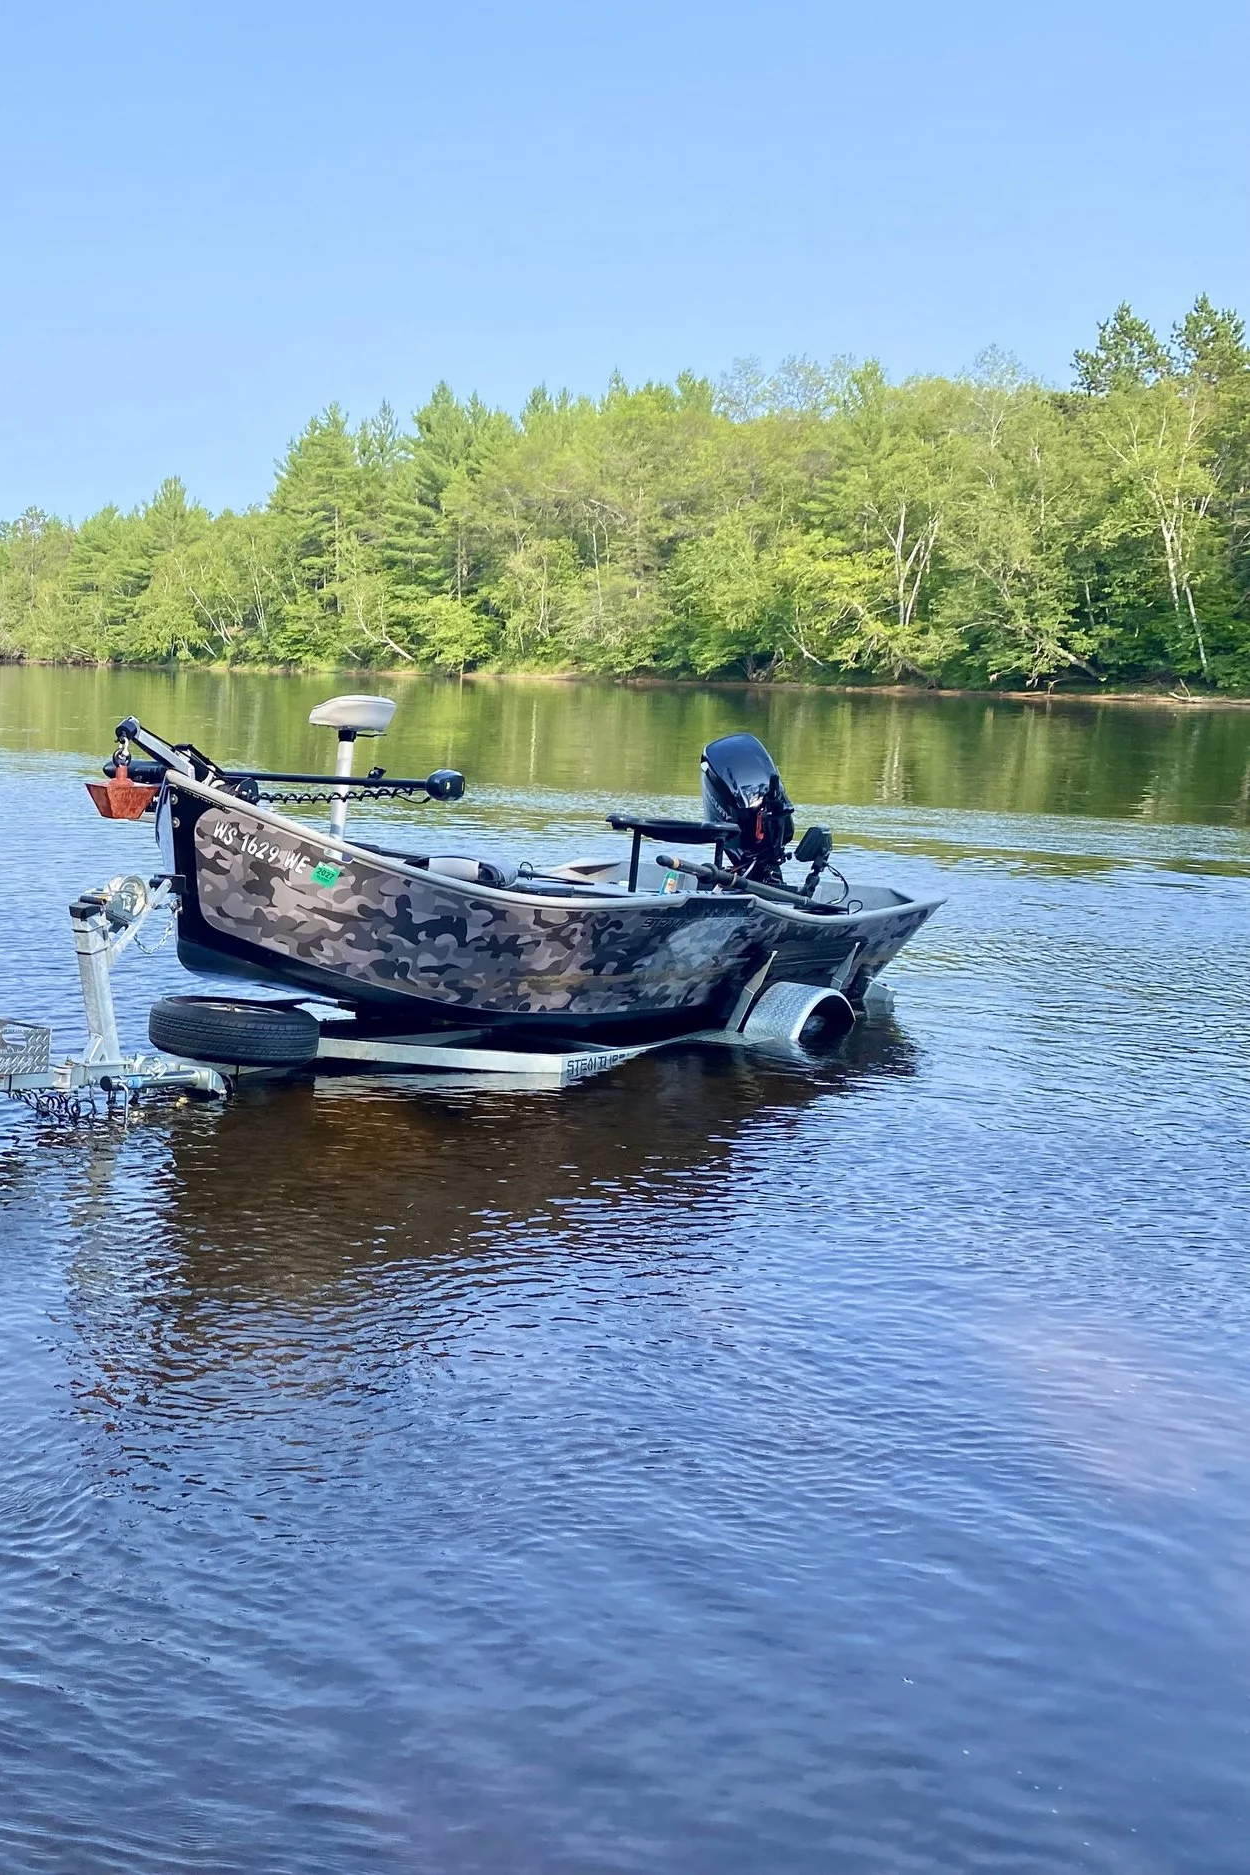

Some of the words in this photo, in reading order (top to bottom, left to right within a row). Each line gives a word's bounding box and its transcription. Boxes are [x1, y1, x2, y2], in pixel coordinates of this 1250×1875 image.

[213, 820, 238, 846] WS
[240, 834, 280, 863] 1629
[284, 850, 311, 875] WE
[316, 868, 335, 880] 2027
